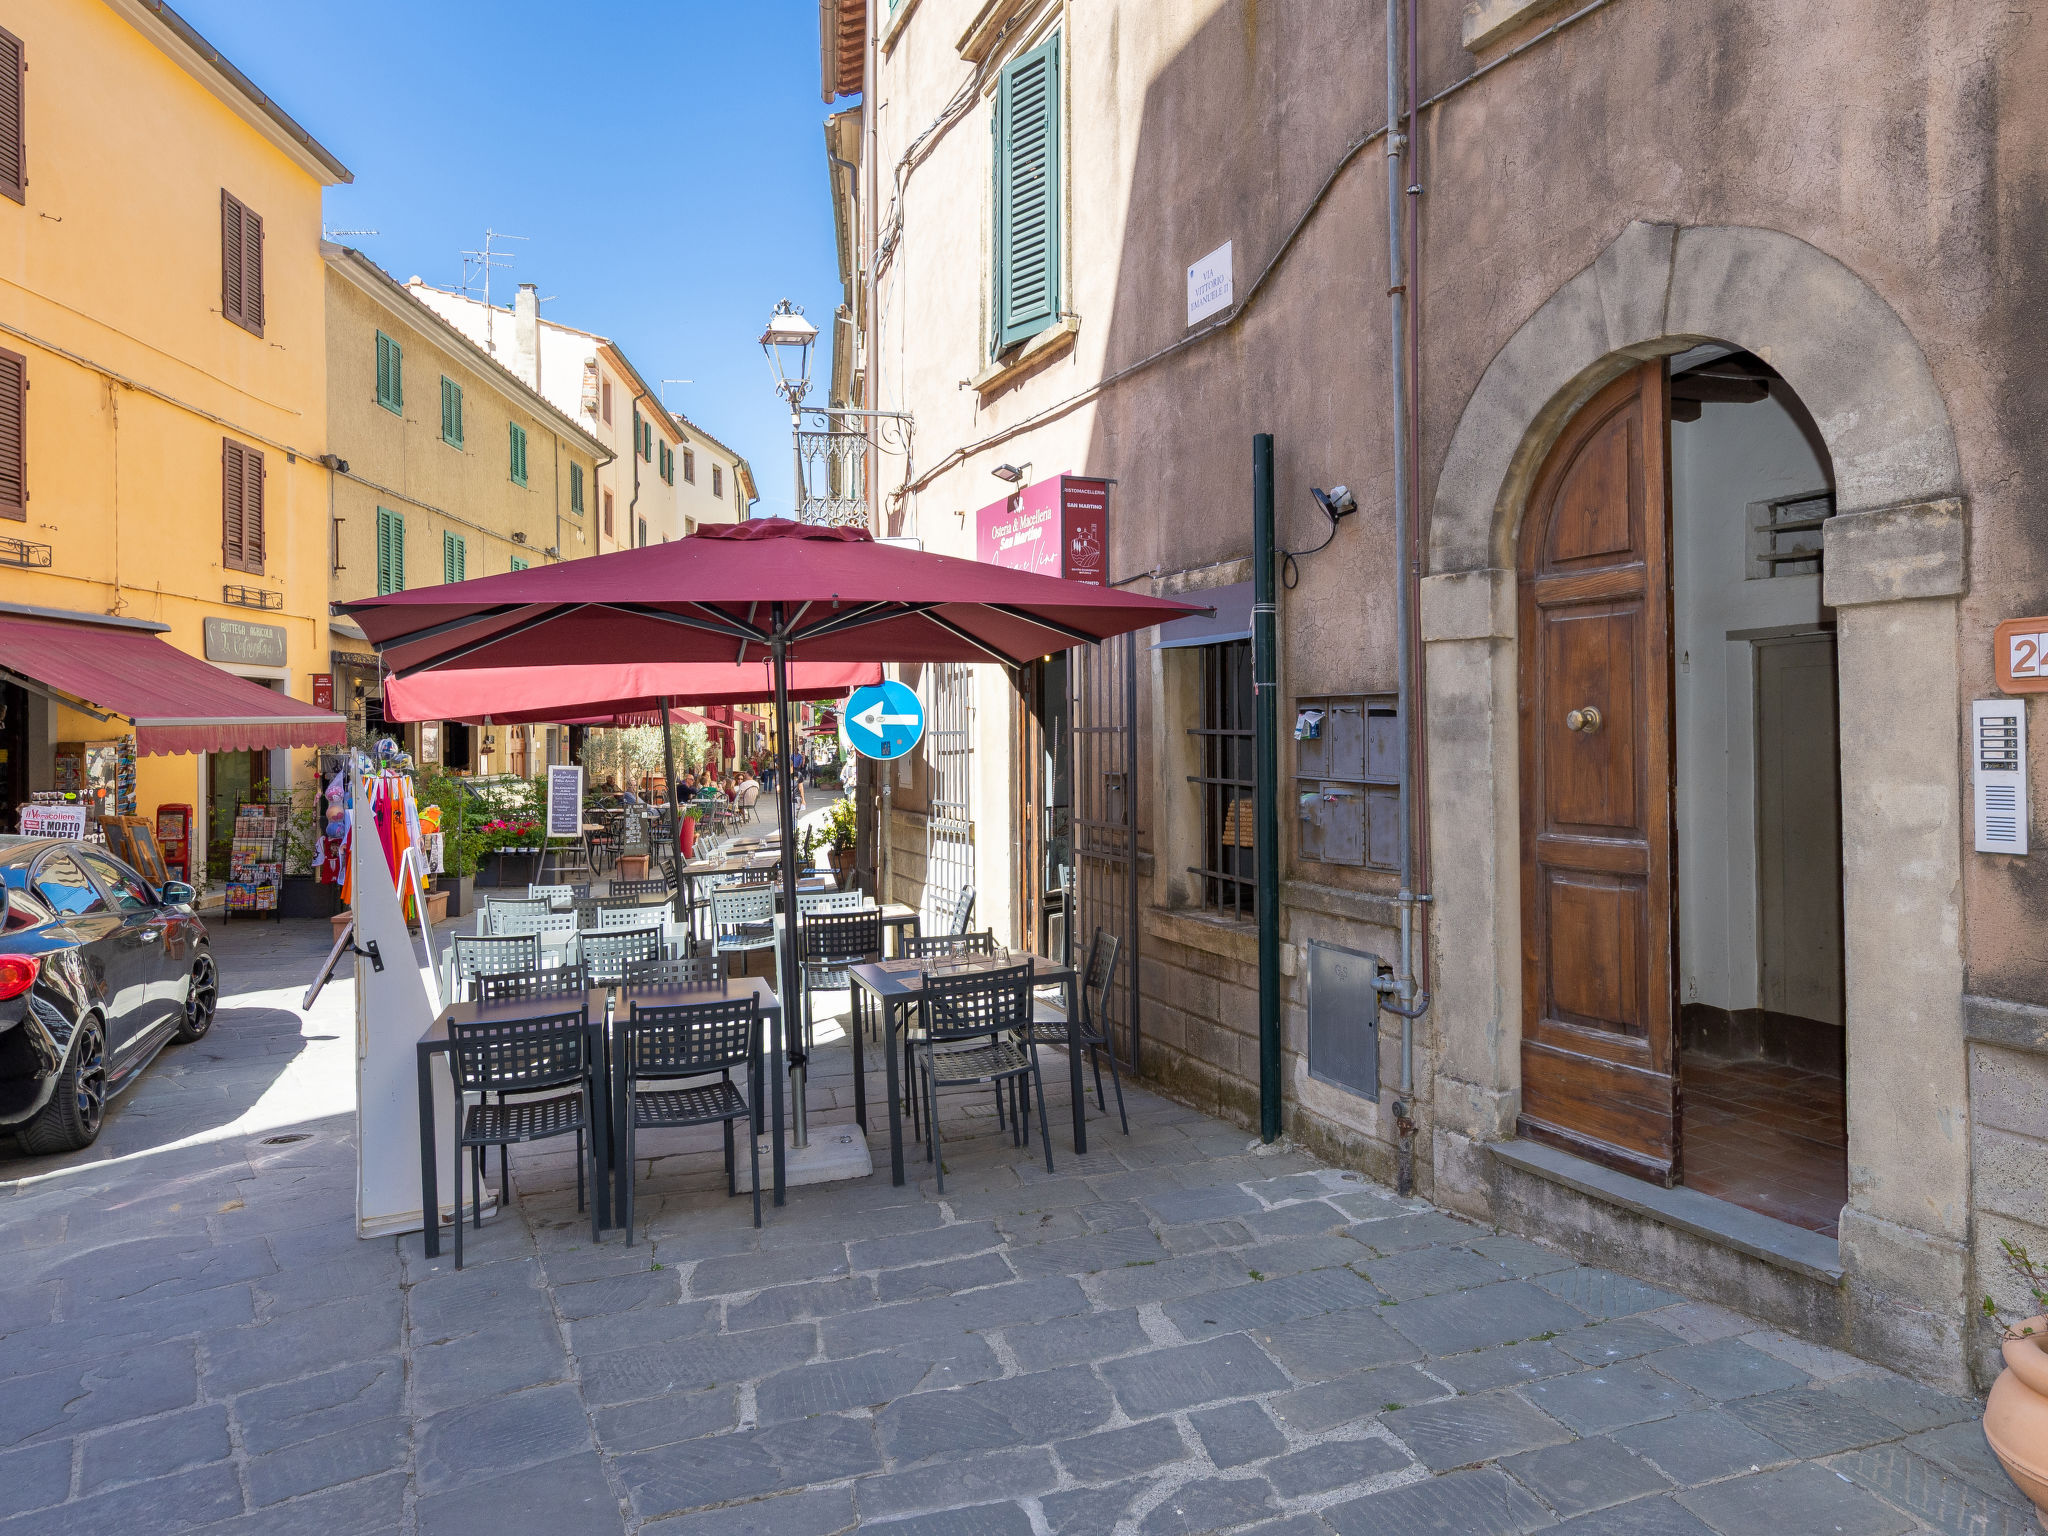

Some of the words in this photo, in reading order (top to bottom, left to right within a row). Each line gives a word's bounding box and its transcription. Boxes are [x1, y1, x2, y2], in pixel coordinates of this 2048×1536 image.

[1195, 274, 1224, 296] VITTORIO
[1203, 268, 1214, 281] VIA
[1191, 287, 1223, 311] EMANUELE
[1079, 502, 1103, 511] MARTINO
[991, 521, 1012, 540] Osteria
[1012, 518, 1019, 533] &
[1020, 506, 1052, 529] Macelleria
[999, 535, 1014, 552] San
[1014, 526, 1043, 546] Martino
[220, 622, 246, 636] BOTTEGA
[250, 626, 273, 639] AGRICOLA
[2013, 640, 2048, 673] 2
[47, 821, 80, 832] MORTO
